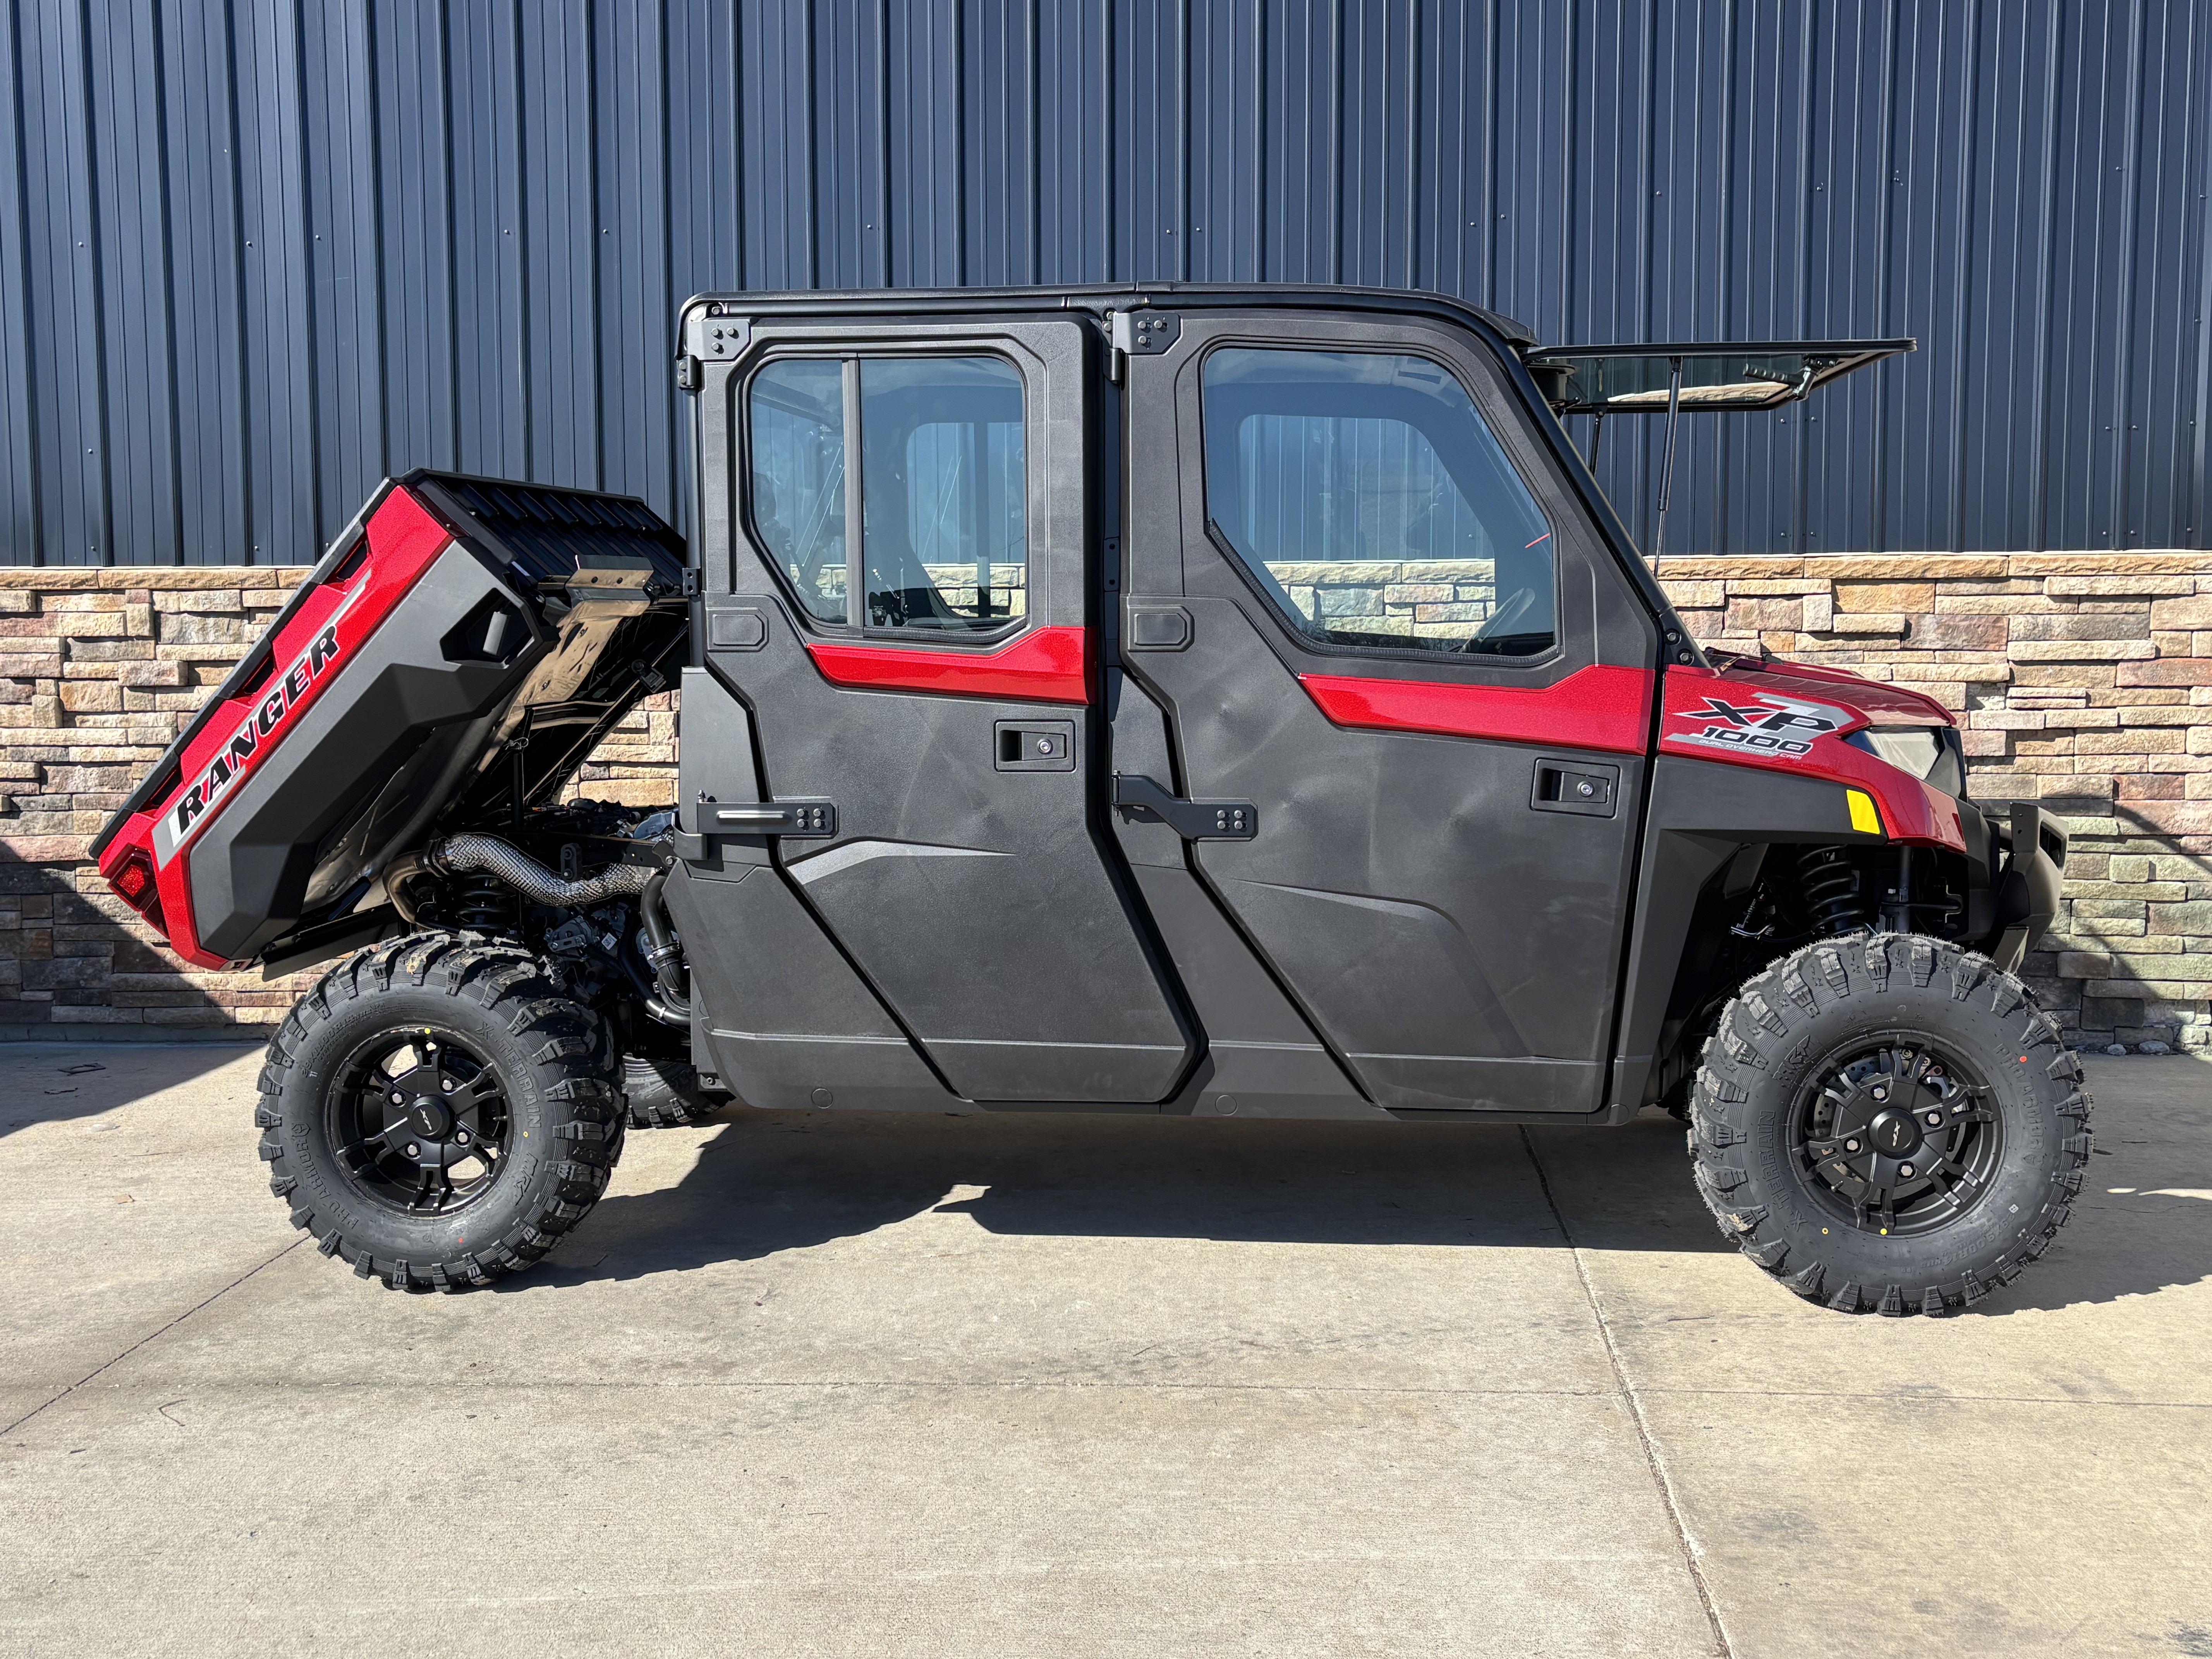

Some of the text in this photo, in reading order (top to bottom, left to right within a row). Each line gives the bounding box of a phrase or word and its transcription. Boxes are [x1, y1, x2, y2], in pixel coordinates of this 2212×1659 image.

[176, 625, 339, 835] RANGER
[1673, 697, 1838, 733] XP
[1702, 726, 1813, 755] 1000
[1726, 744, 1779, 756] OVERHEAD
[1994, 1043, 2044, 1149] PRO ARMOR
[420, 1109, 432, 1130] XP
[1893, 1121, 1900, 1147] XP
[296, 1139, 359, 1230] PRO ARMOR
